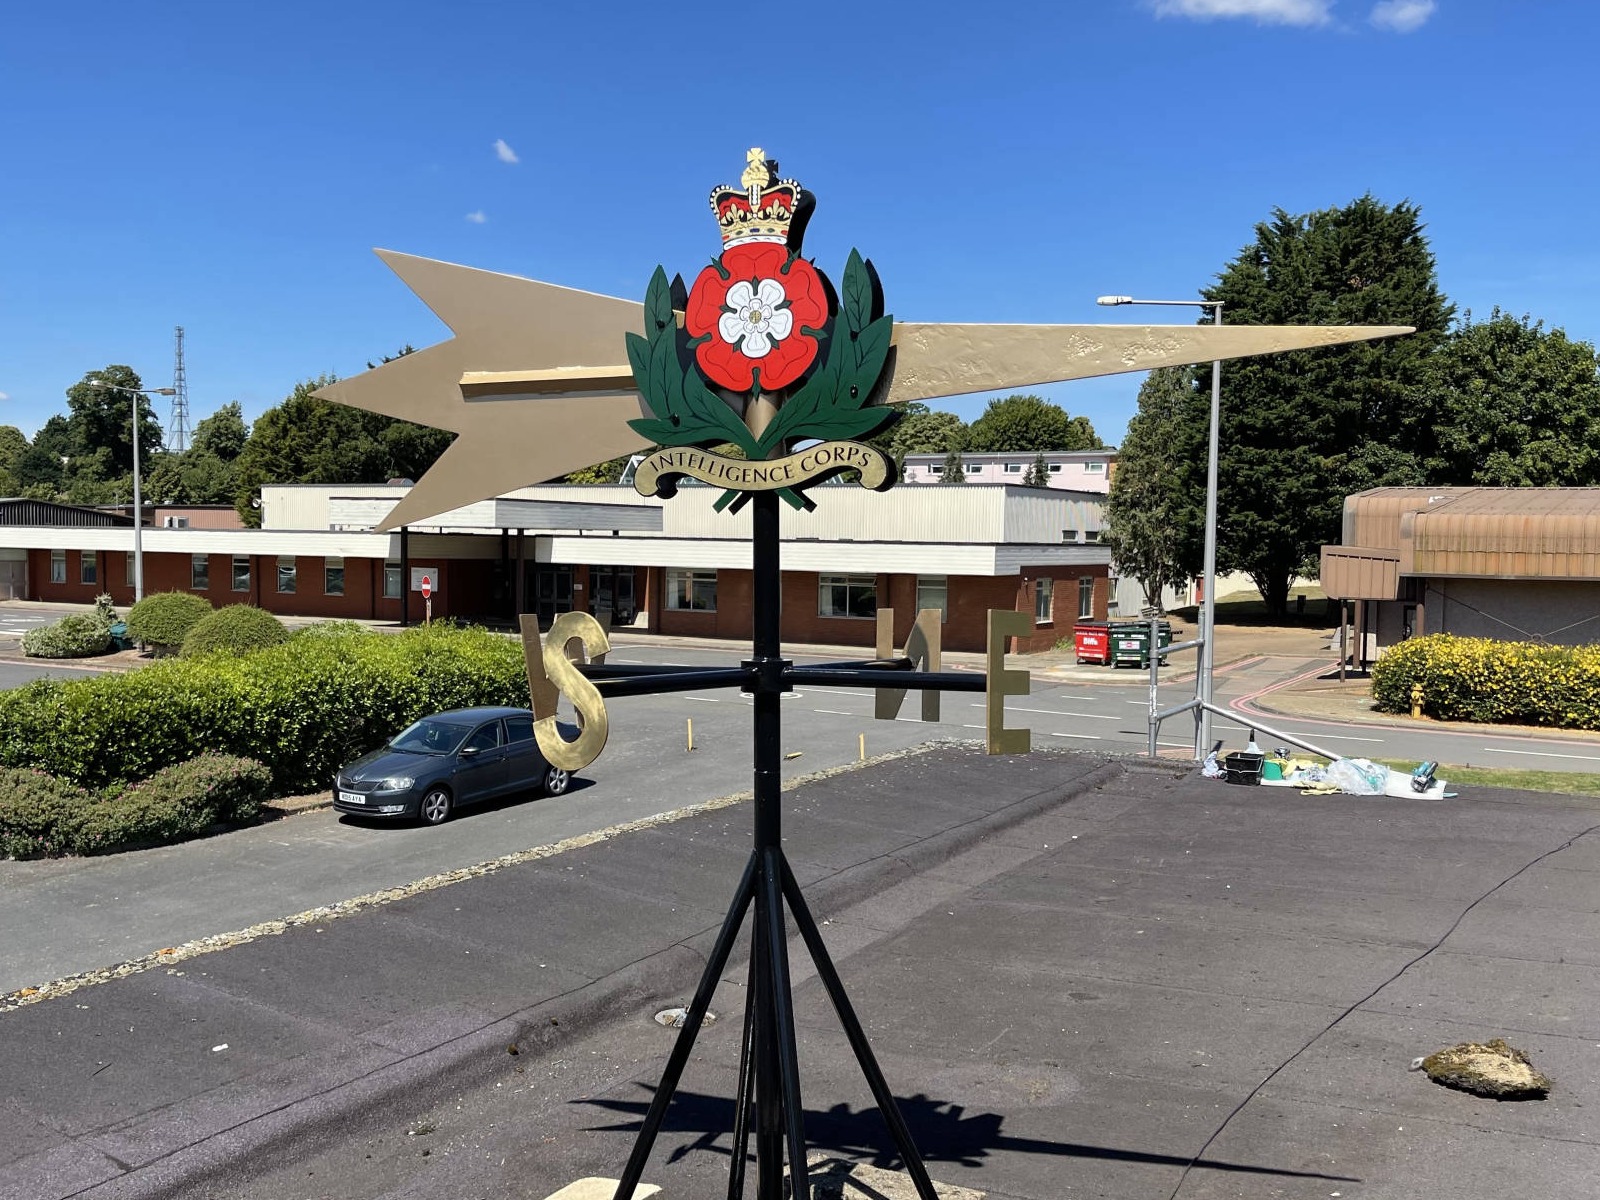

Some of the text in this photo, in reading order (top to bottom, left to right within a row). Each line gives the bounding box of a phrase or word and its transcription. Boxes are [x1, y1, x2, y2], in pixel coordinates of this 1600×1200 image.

[650, 446, 872, 483] INTELLIGENCE CORPS
[533, 611, 611, 771] S
[986, 609, 1031, 755] E
